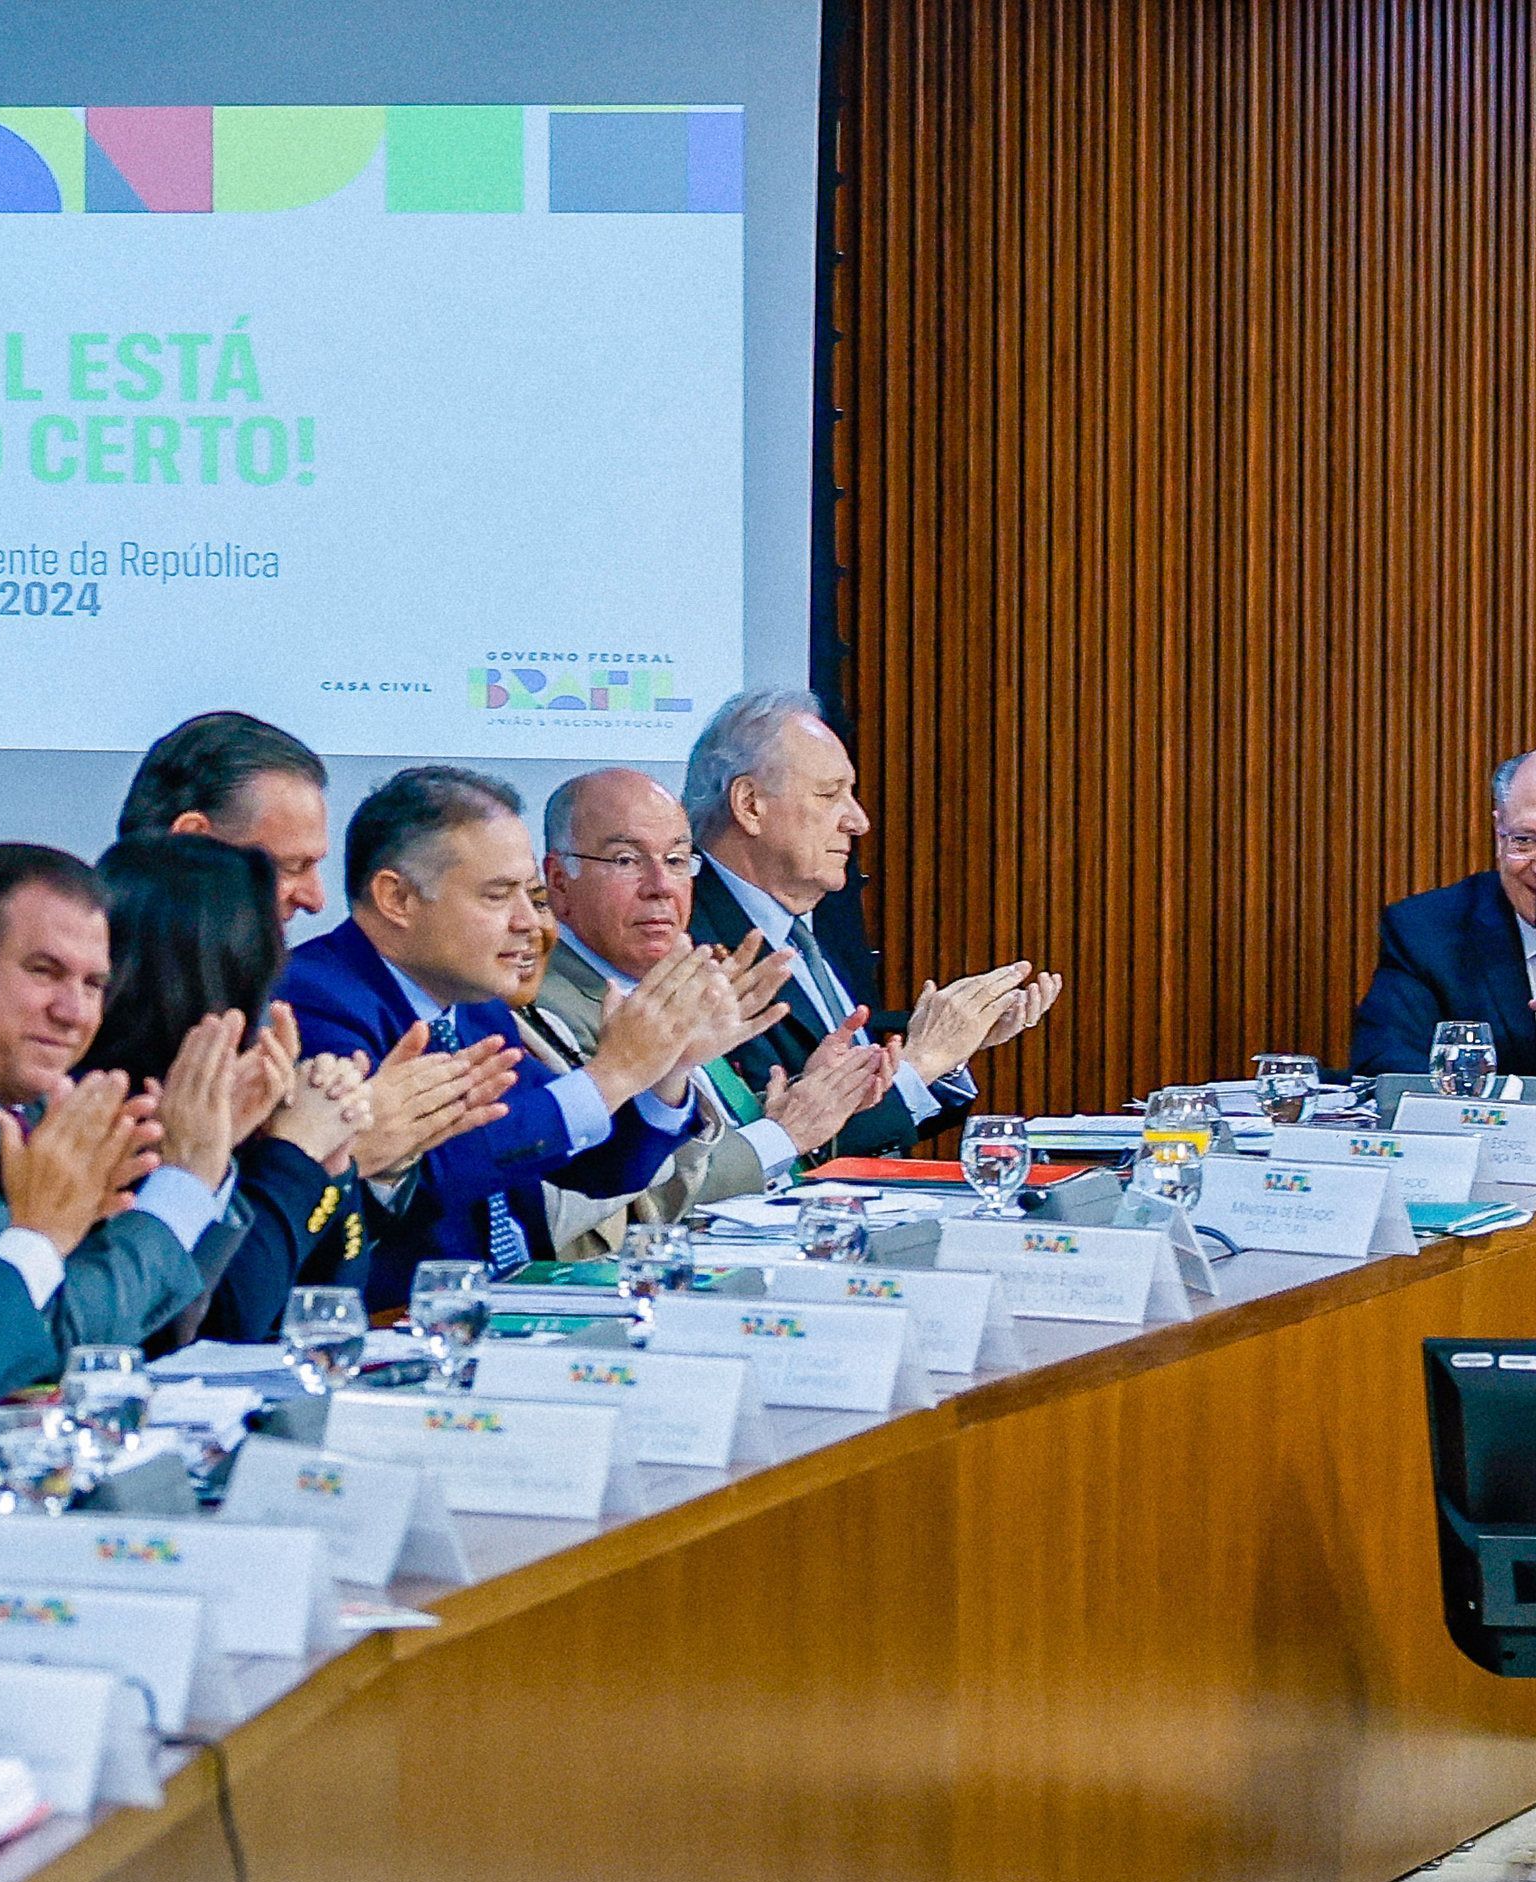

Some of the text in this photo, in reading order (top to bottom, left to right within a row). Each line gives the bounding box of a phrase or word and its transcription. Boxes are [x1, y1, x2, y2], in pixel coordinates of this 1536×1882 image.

[68, 313, 265, 404] ESTÁ
[29, 413, 318, 488] CERTO!
[68, 541, 109, 578] da
[120, 541, 280, 585] República
[486, 651, 675, 665] GOVERNO FEDERAL
[320, 680, 433, 694] CASA CIVIL
[467, 667, 693, 713] BRASIL
